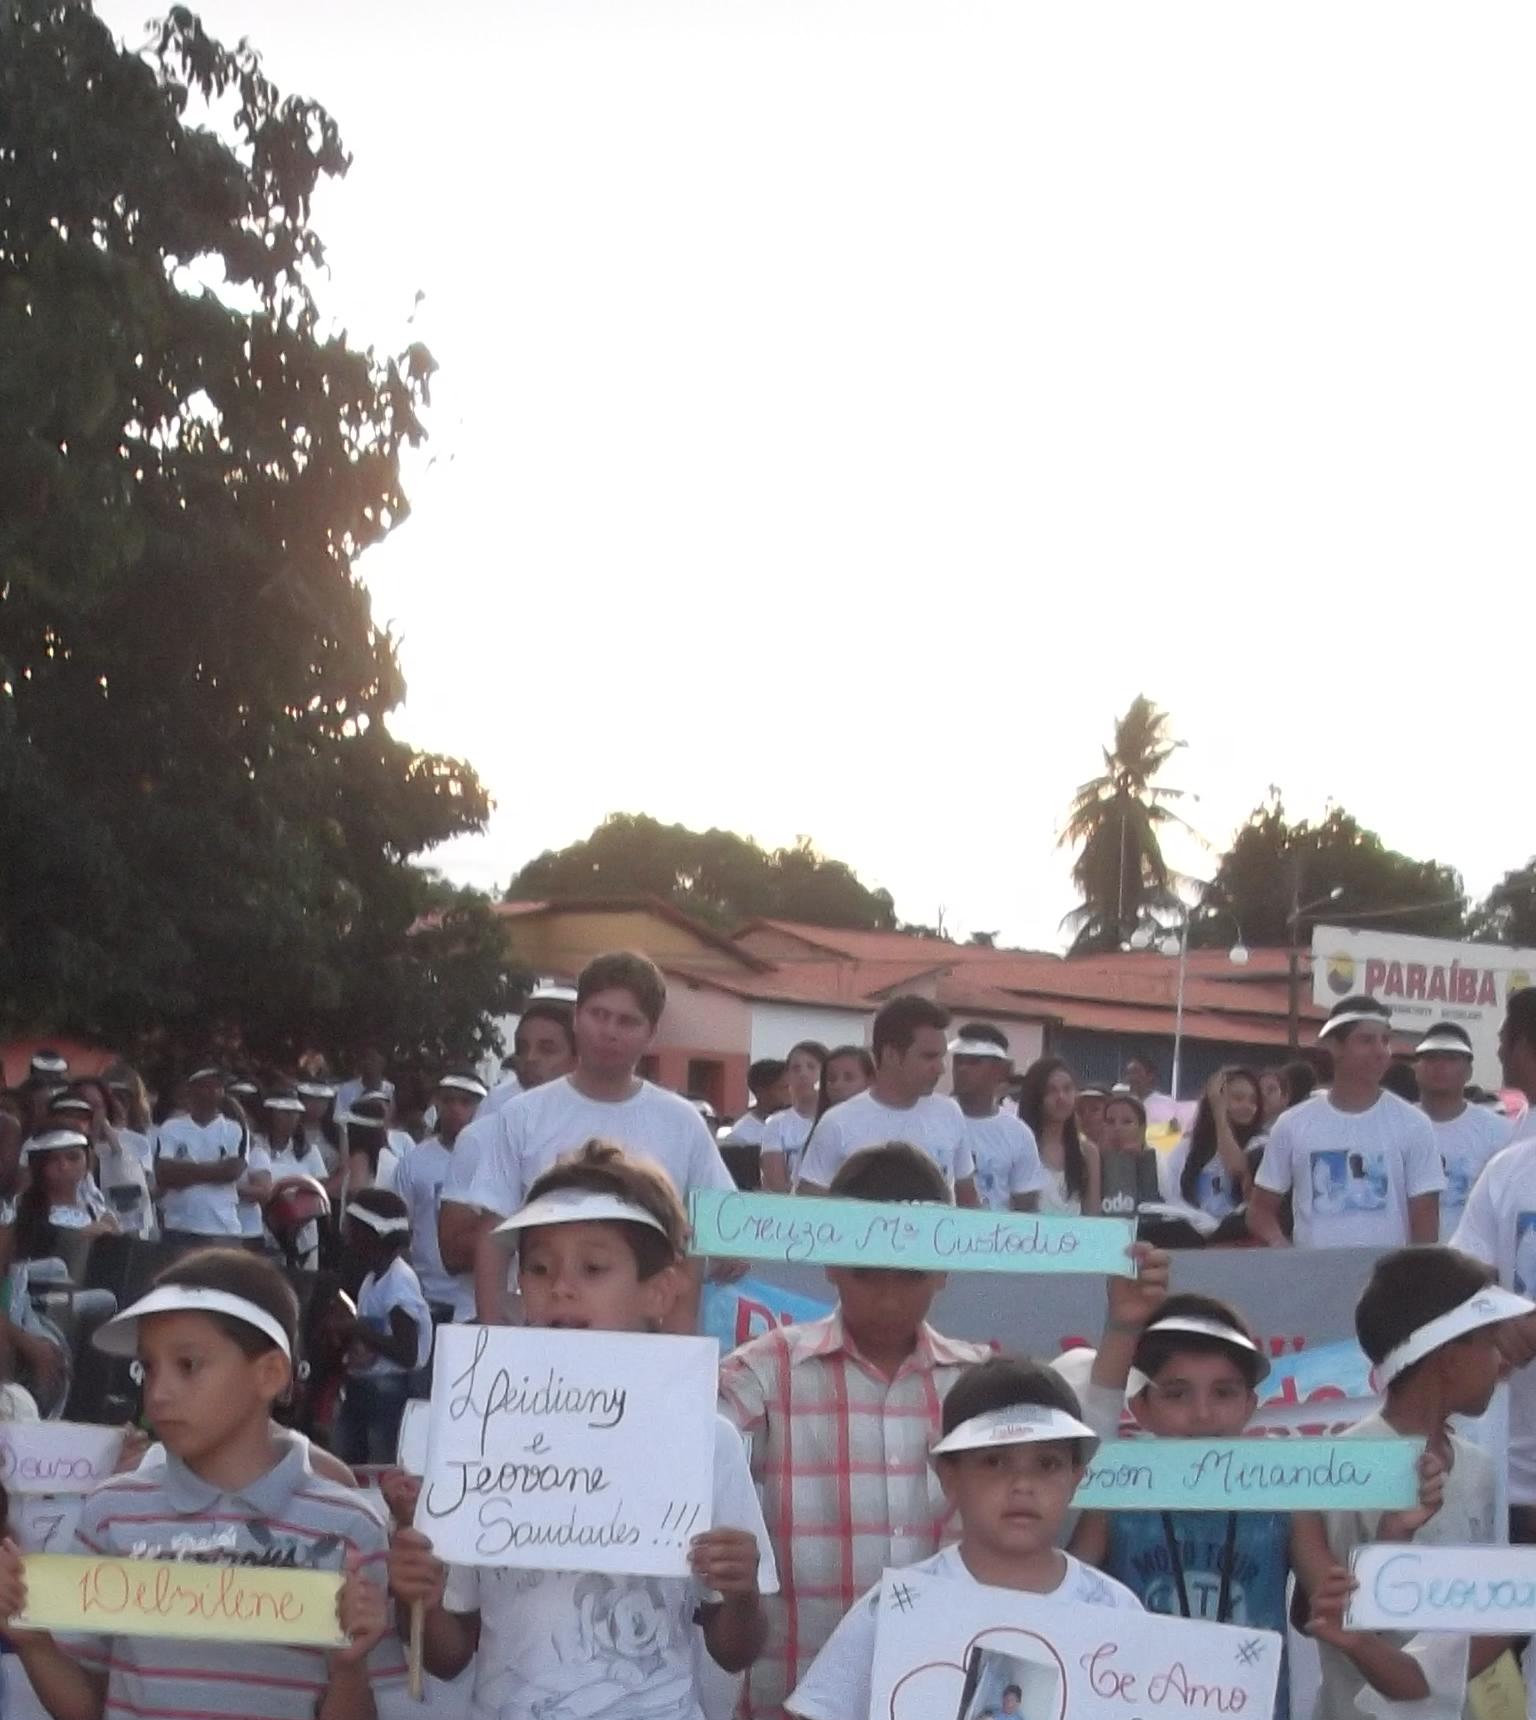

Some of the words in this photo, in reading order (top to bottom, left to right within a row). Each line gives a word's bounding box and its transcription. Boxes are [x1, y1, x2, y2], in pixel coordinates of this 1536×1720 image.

[1365, 957, 1498, 1007] PARAÍBA
[523, 1432, 551, 1455] e
[1183, 1447, 1372, 1494] Miranda
[1148, 1662, 1249, 1713] Amo
